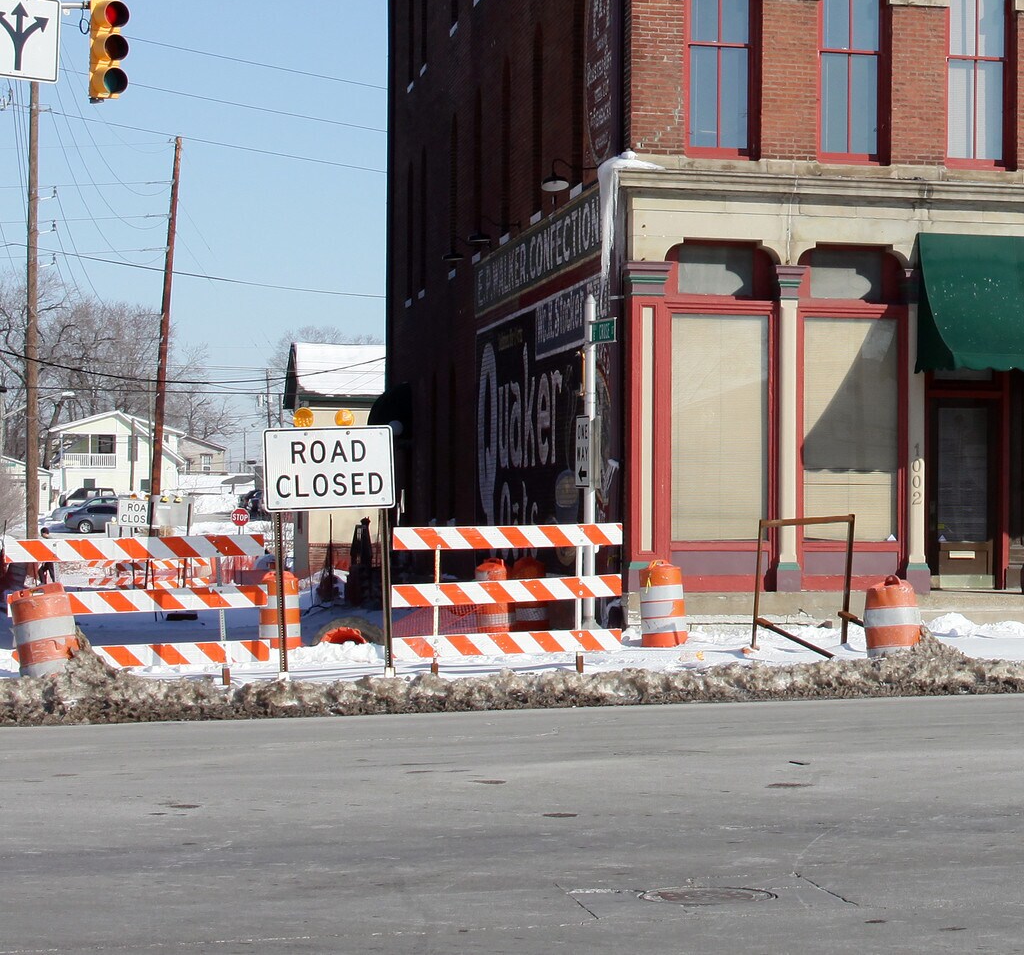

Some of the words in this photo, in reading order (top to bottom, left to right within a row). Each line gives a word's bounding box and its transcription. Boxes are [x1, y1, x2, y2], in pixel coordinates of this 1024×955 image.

[530, 196, 600, 278] CONFECTION
[477, 342, 563, 525] Quaker
[577, 424, 588, 440] ONE
[291, 440, 365, 463] ROAD
[577, 446, 589, 461] WAY
[276, 472, 383, 498] CLOSED
[911, 443, 922, 505] 1002
[121, 514, 146, 523] CLOS
[127, 503, 147, 512] ROA
